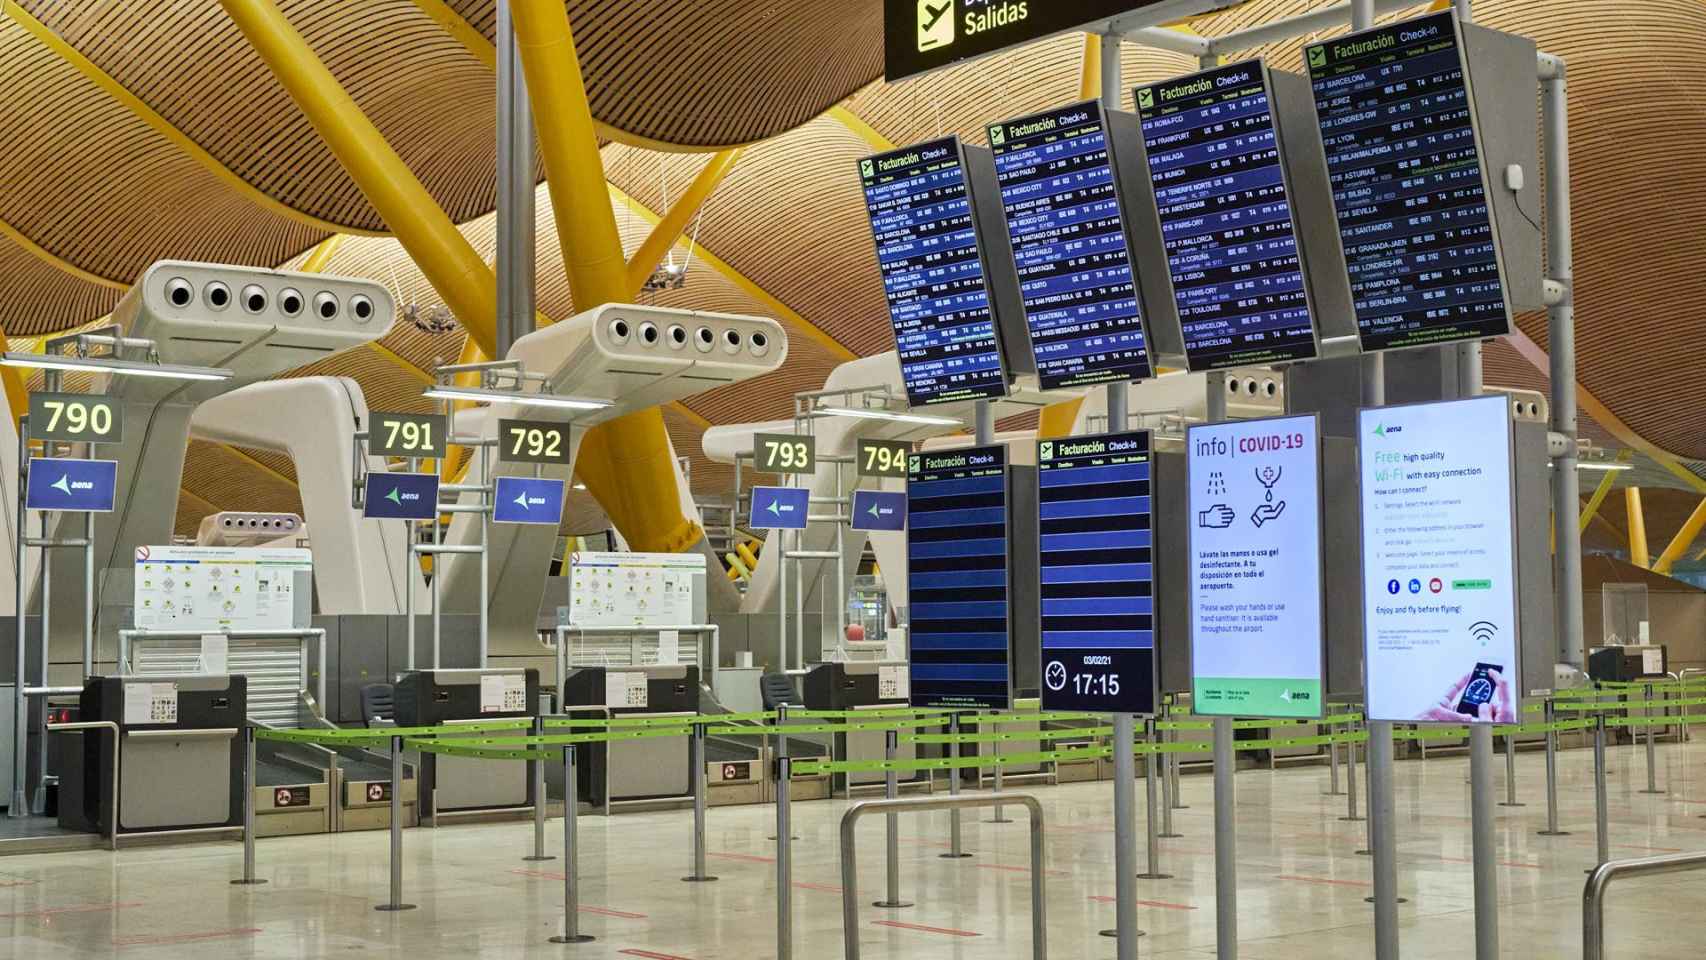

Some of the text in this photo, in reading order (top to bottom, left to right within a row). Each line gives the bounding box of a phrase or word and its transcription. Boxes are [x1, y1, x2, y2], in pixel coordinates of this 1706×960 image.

[965, 2, 1027, 35] Salidas
[1334, 26, 1438, 59] Facturación Check-in
[1160, 72, 1249, 100] Facturación Check-in
[1010, 112, 1088, 138] Facturación Check-in
[878, 148, 947, 171] Facturación Check-in
[1355, 222, 1392, 234] SANTANDER
[44, 402, 111, 434] 790
[384, 420, 434, 450] 791
[511, 428, 560, 457] 792
[1197, 433, 1303, 456] info COVID-19
[765, 442, 808, 467] 793
[1060, 440, 1137, 455] Facturación Check-in
[1375, 451, 1444, 463] Free high quality
[864, 447, 906, 472] 794
[926, 455, 994, 469] Facturación Check-in
[1375, 467, 1482, 482] Wi-Fi with easy connection
[1269, 548, 1279, 557] gel
[1200, 571, 1232, 579] disposición
[1376, 606, 1393, 615] Enjoy
[1084, 656, 1111, 664] 03/02/21
[1073, 674, 1119, 695] 17:15
